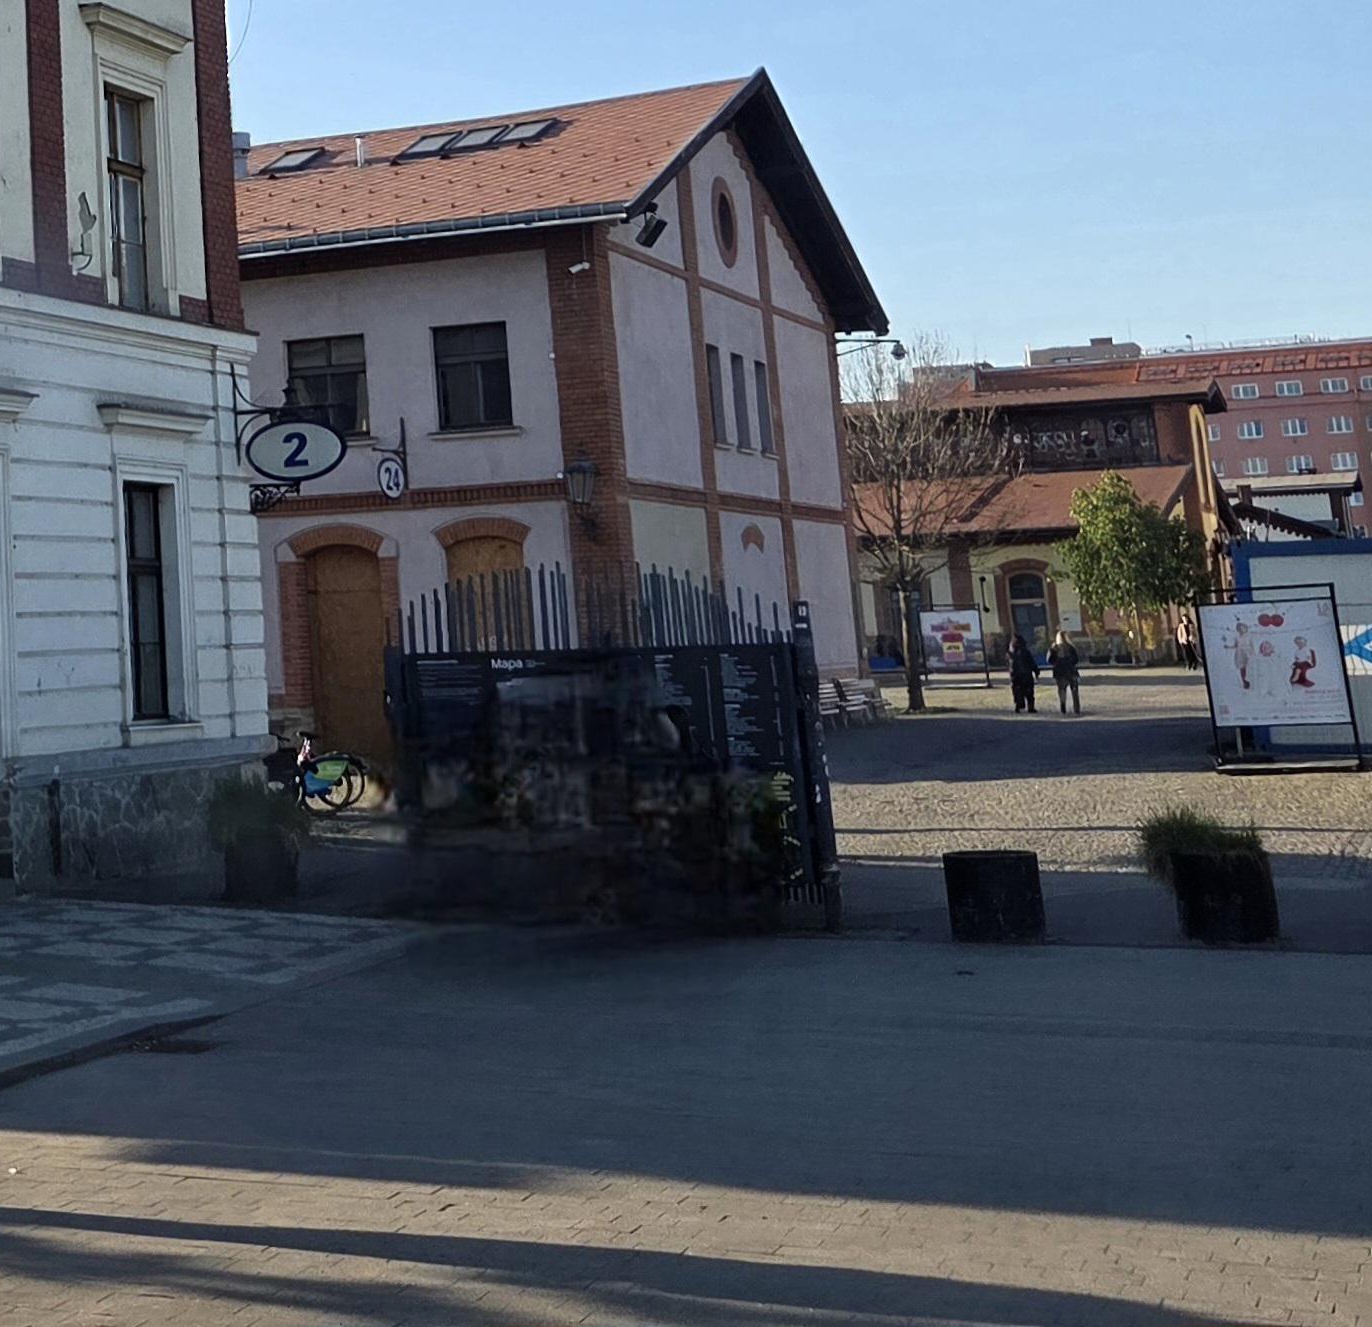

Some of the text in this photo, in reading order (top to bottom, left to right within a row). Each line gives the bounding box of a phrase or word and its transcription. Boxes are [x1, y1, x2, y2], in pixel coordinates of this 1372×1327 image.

[282, 431, 309, 469] 2
[384, 466, 401, 492] 24
[491, 659, 523, 670] Mapa
